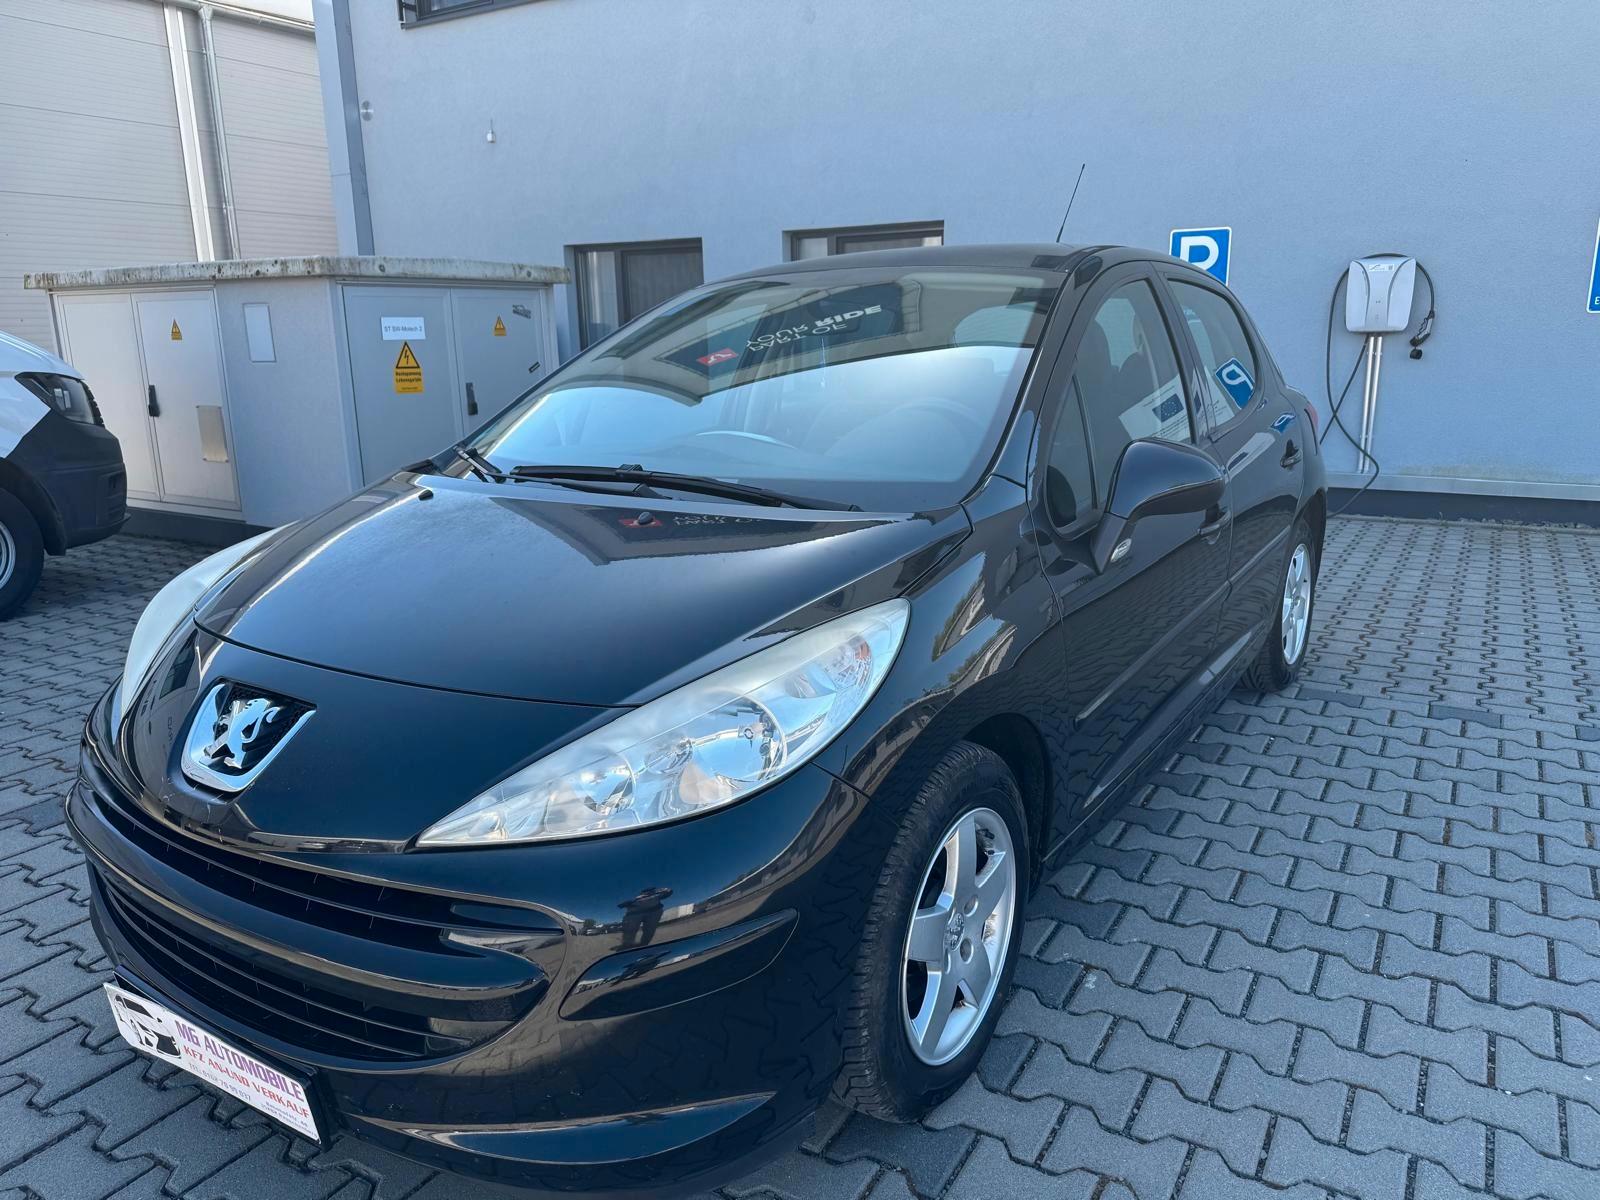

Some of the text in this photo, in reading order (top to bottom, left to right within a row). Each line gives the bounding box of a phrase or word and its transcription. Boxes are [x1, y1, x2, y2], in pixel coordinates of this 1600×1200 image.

[1179, 236, 1219, 270] P
[175, 1019, 305, 1103] MG AUTOMOBILE
[182, 1045, 206, 1064] KFZ
[252, 1081, 310, 1119] VERKAUF
